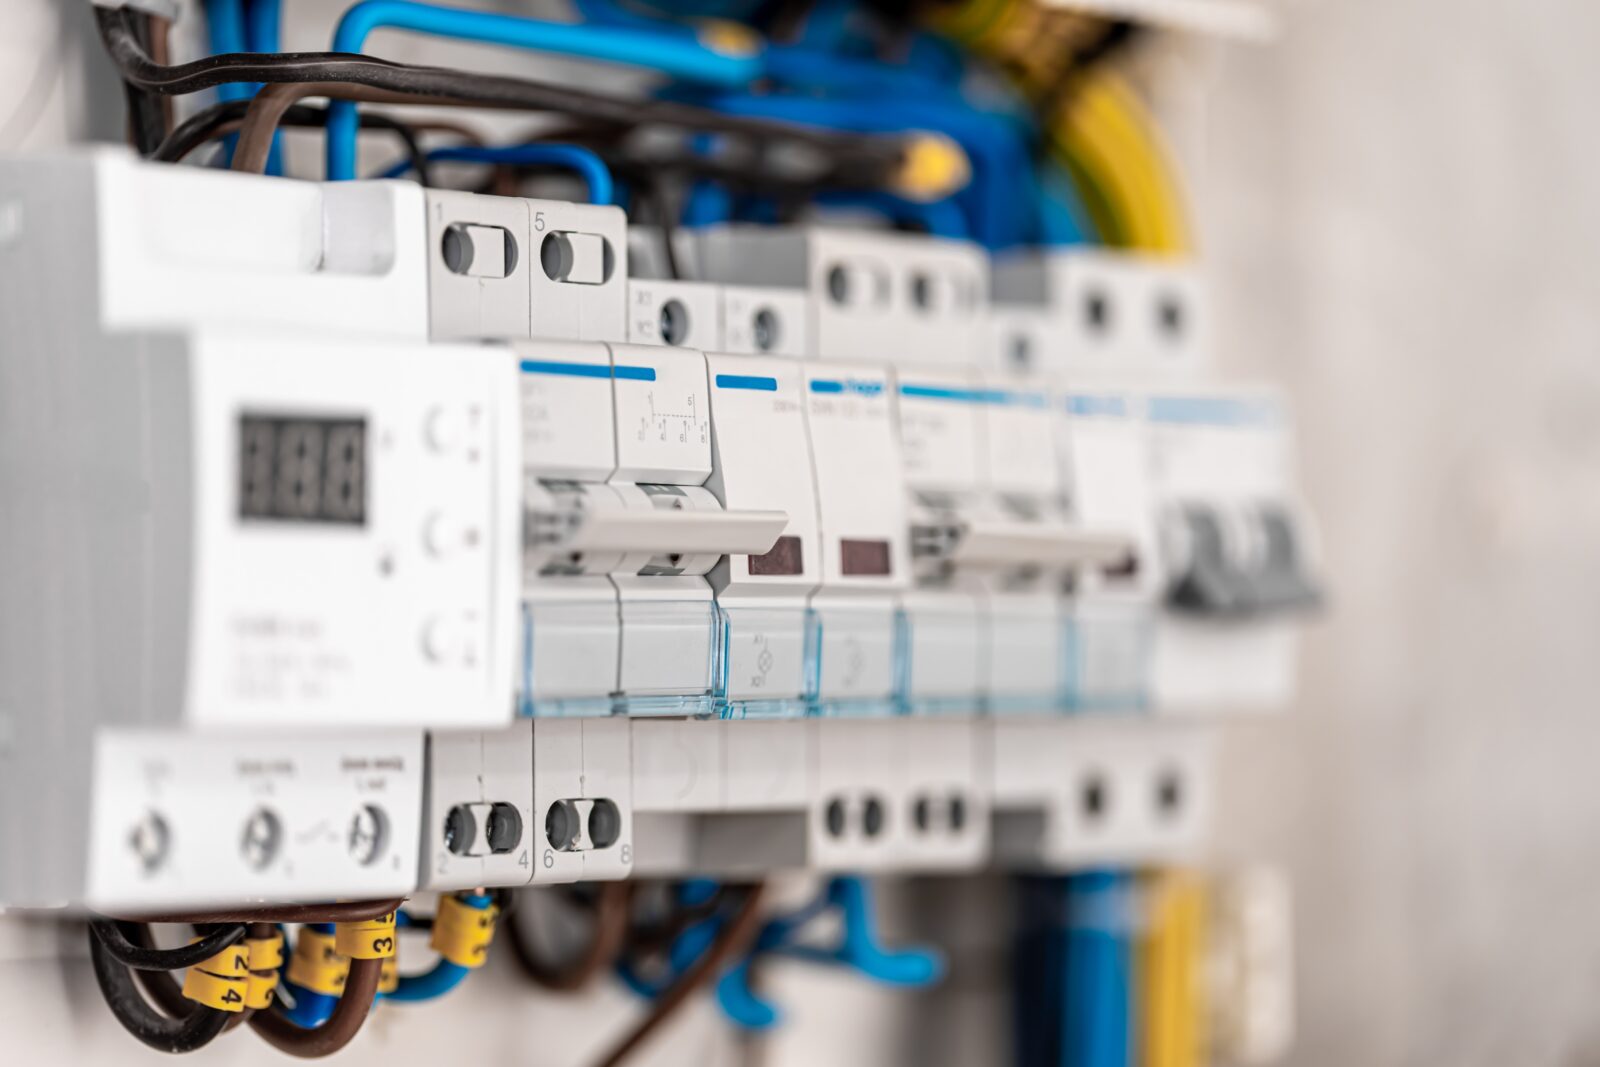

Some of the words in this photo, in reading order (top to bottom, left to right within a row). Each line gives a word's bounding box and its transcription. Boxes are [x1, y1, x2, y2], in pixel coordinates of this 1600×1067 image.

[534, 210, 545, 232] 5
[518, 850, 530, 870] 4
[543, 849, 554, 869] 6
[620, 844, 632, 865] 8
[373, 937, 393, 954] 3
[234, 954, 249, 971] 2
[221, 988, 242, 1004] 4
